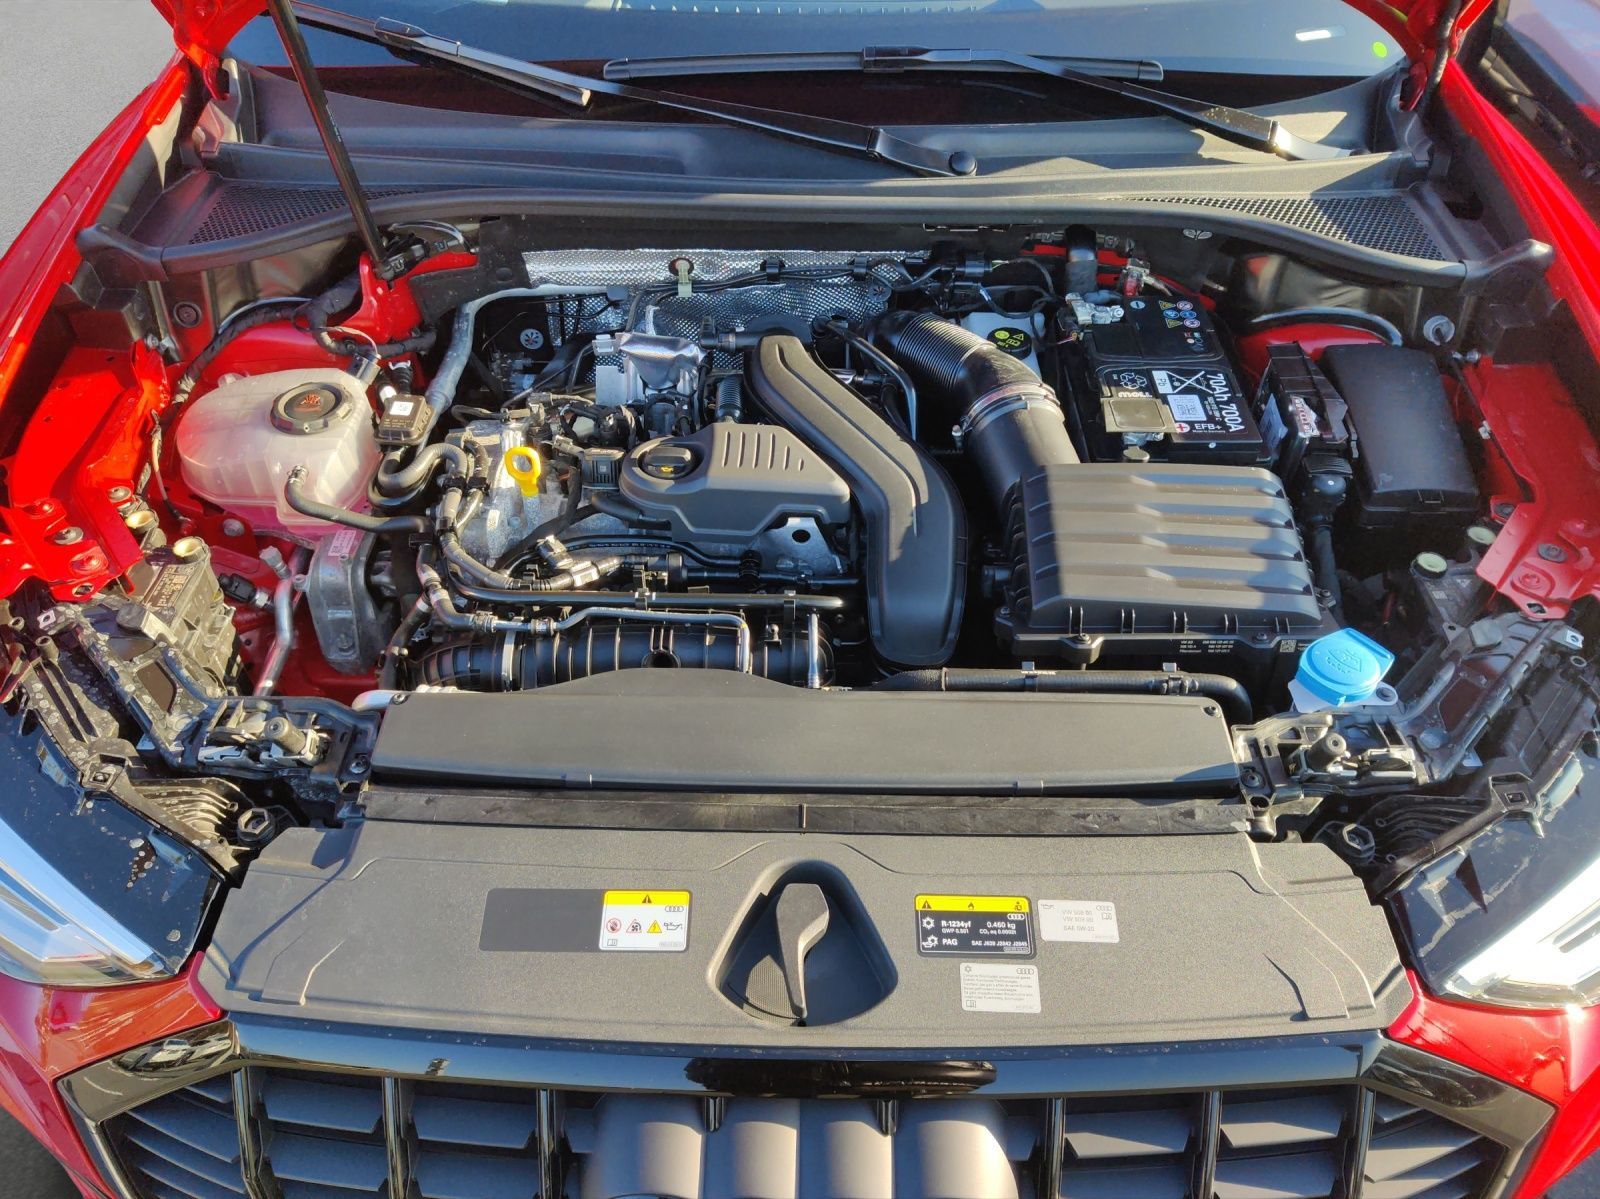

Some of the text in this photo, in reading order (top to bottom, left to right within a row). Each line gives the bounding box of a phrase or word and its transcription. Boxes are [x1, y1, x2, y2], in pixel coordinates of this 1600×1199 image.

[1206, 373, 1231, 401] 70Ah
[1219, 403, 1245, 432] 700A
[941, 920, 971, 928] R-1234yf
[1007, 922, 1016, 930] kg
[942, 938, 958, 946] PAG
